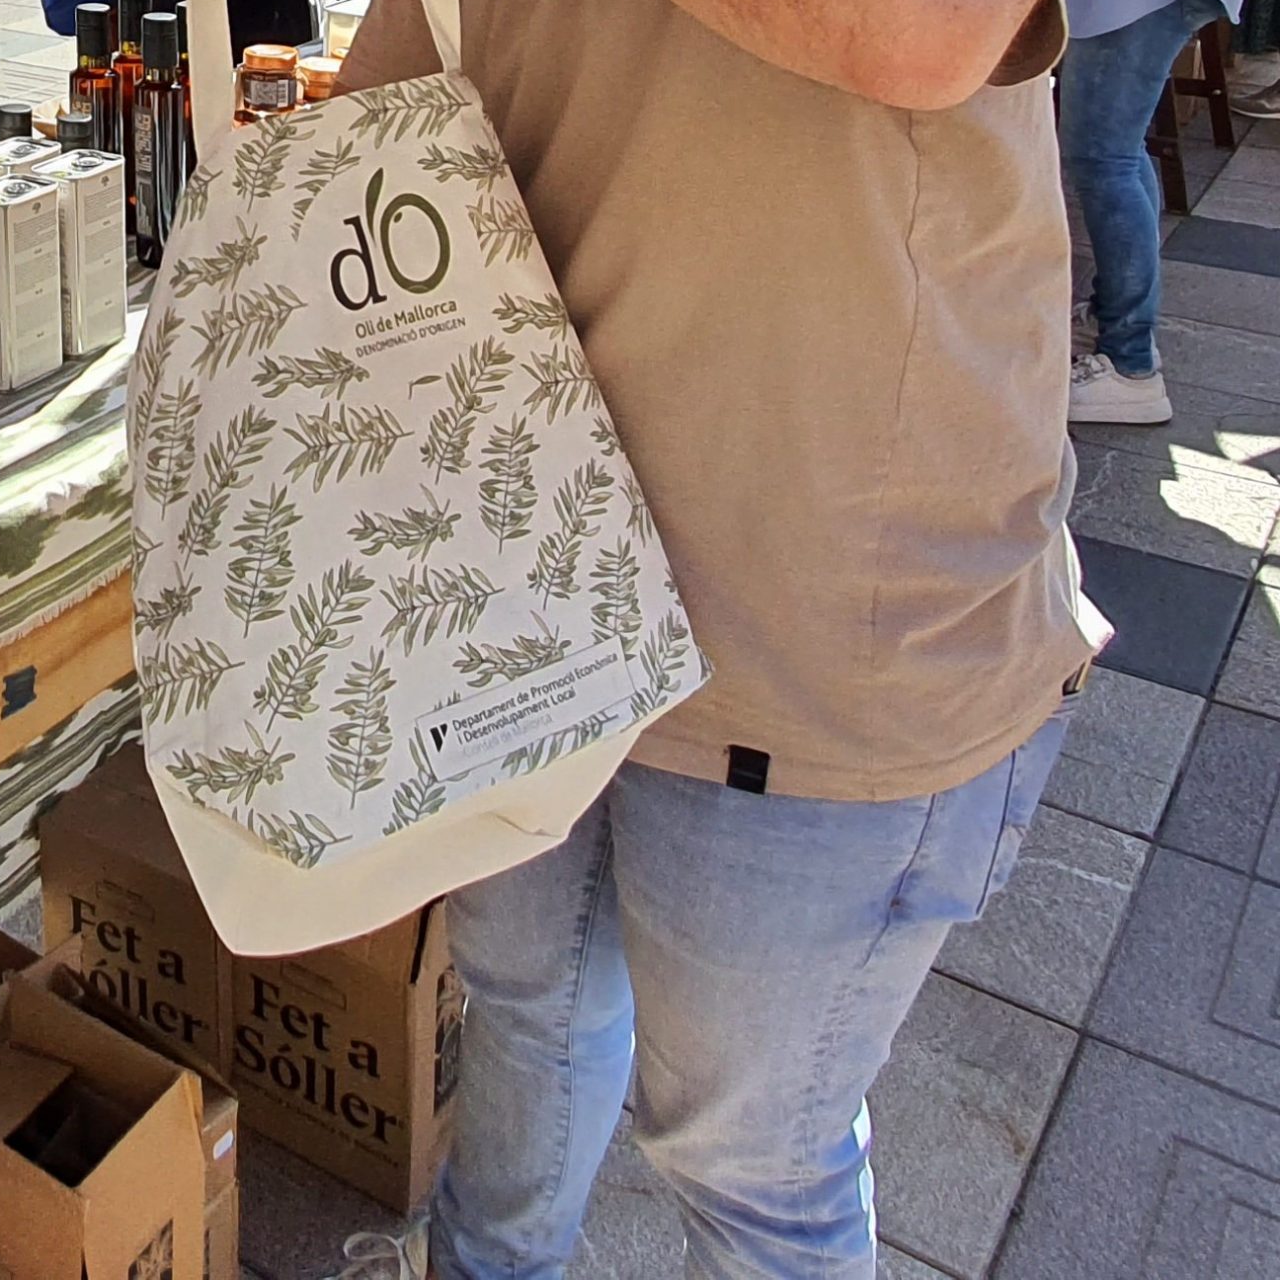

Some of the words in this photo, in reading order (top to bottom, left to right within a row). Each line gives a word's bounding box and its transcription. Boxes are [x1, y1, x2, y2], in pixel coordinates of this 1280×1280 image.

[355, 320, 375, 339] Oli
[376, 316, 393, 333] de
[393, 300, 457, 328] Mallorca
[355, 329, 418, 358] DENOMINACIÓ
[419, 317, 466, 339] D'ORIGEN
[452, 696, 516, 733] Departament
[516, 690, 529, 705] de
[530, 671, 575, 699] Promoció
[464, 701, 551, 743] Desenvolupament
[551, 687, 577, 706] Local
[70, 895, 142, 964] Fet
[157, 949, 186, 985] a
[87, 958, 203, 1044] óller
[250, 972, 332, 1052] Fet
[347, 1039, 381, 1079] a
[234, 1024, 398, 1145] Sóller
